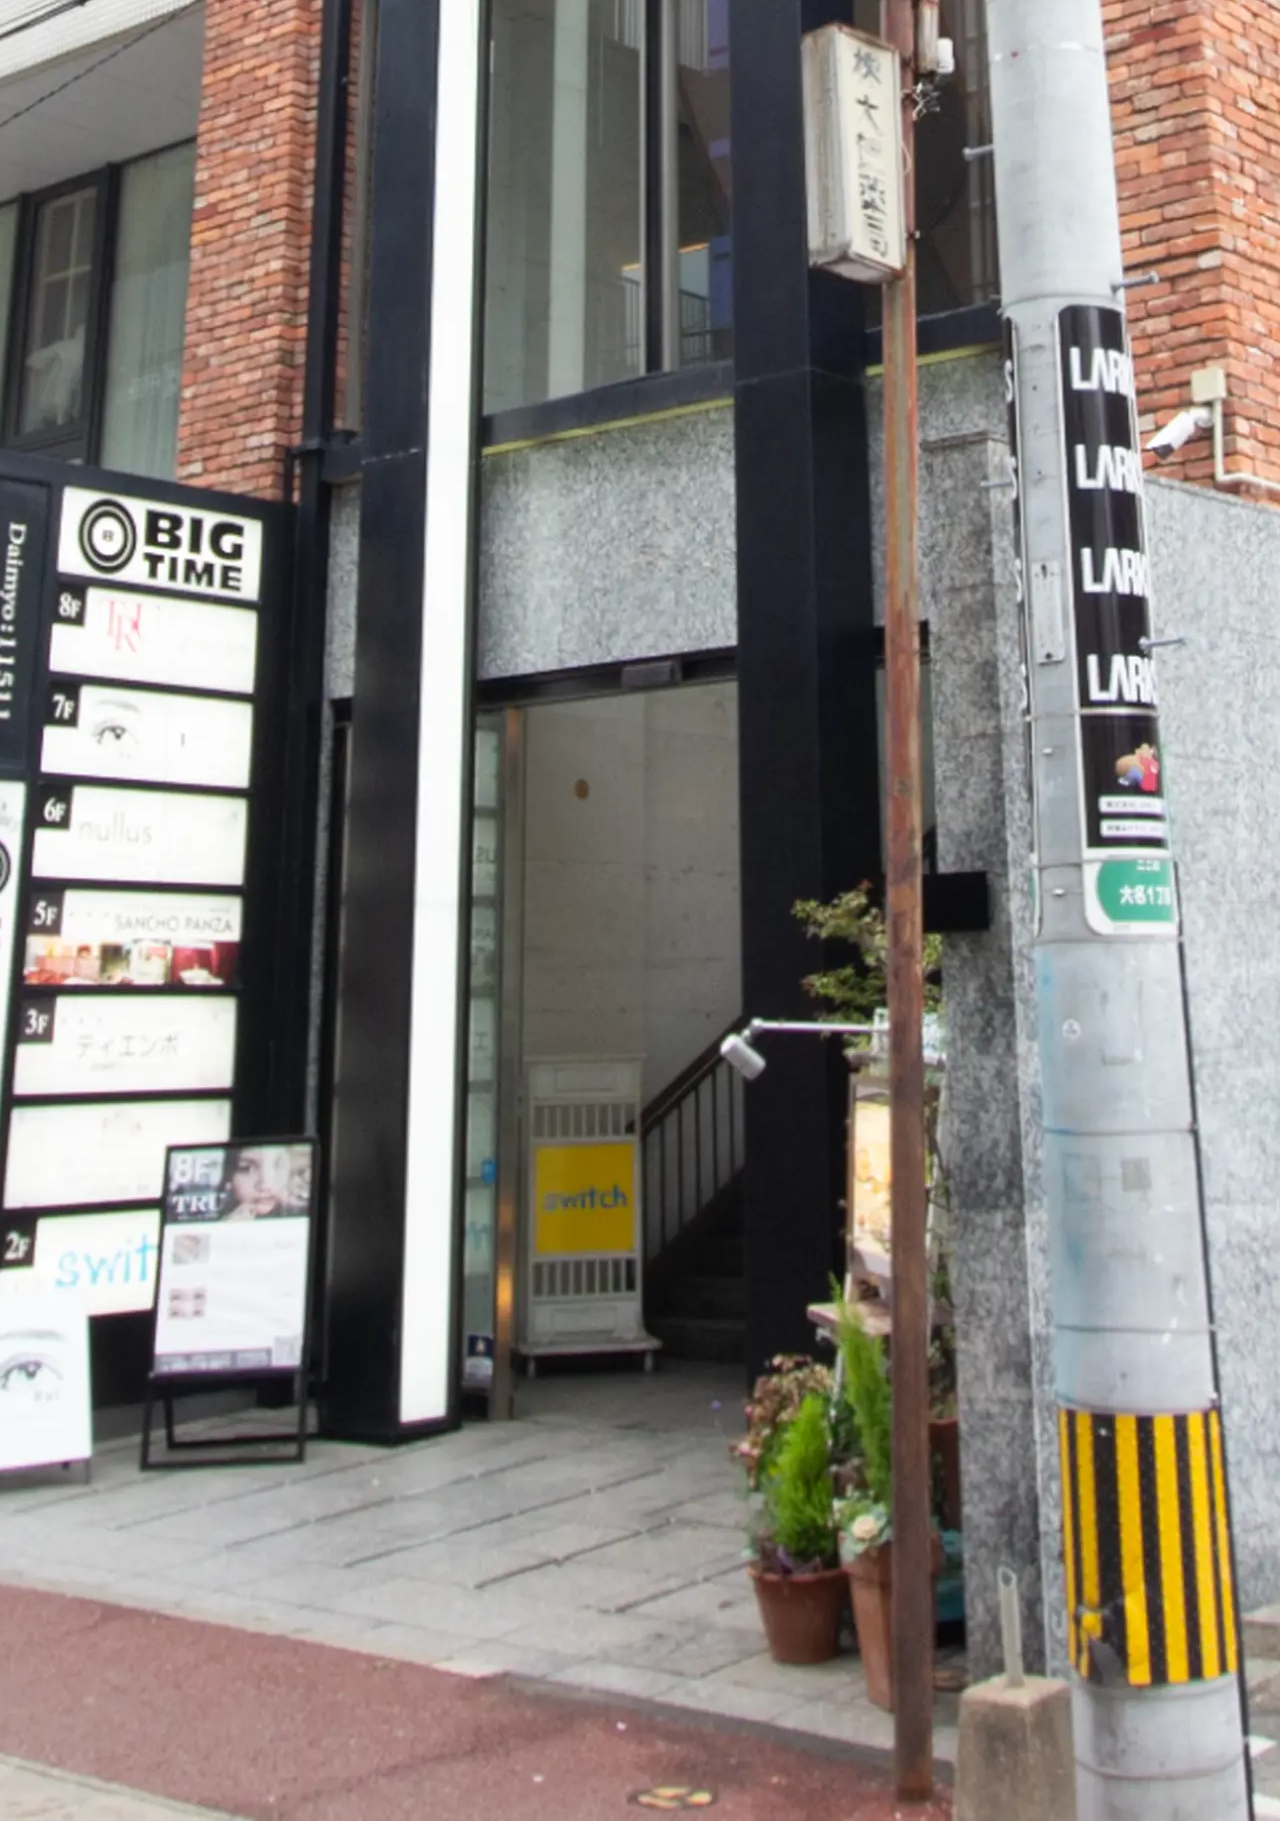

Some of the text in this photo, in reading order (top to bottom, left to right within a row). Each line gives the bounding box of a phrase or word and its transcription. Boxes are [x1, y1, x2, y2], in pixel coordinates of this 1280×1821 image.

[143, 508, 246, 563] BIG
[142, 553, 244, 592] TIME
[57, 591, 82, 620] 8F
[52, 693, 75, 721] 7F
[42, 797, 66, 823] 6F
[77, 810, 153, 845] nullus
[33, 900, 58, 928] 5F
[114, 912, 234, 934] SANCHO PANZA
[24, 1009, 50, 1034] 3F
[543, 1183, 627, 1211] switch
[4, 1231, 30, 1261] 2F
